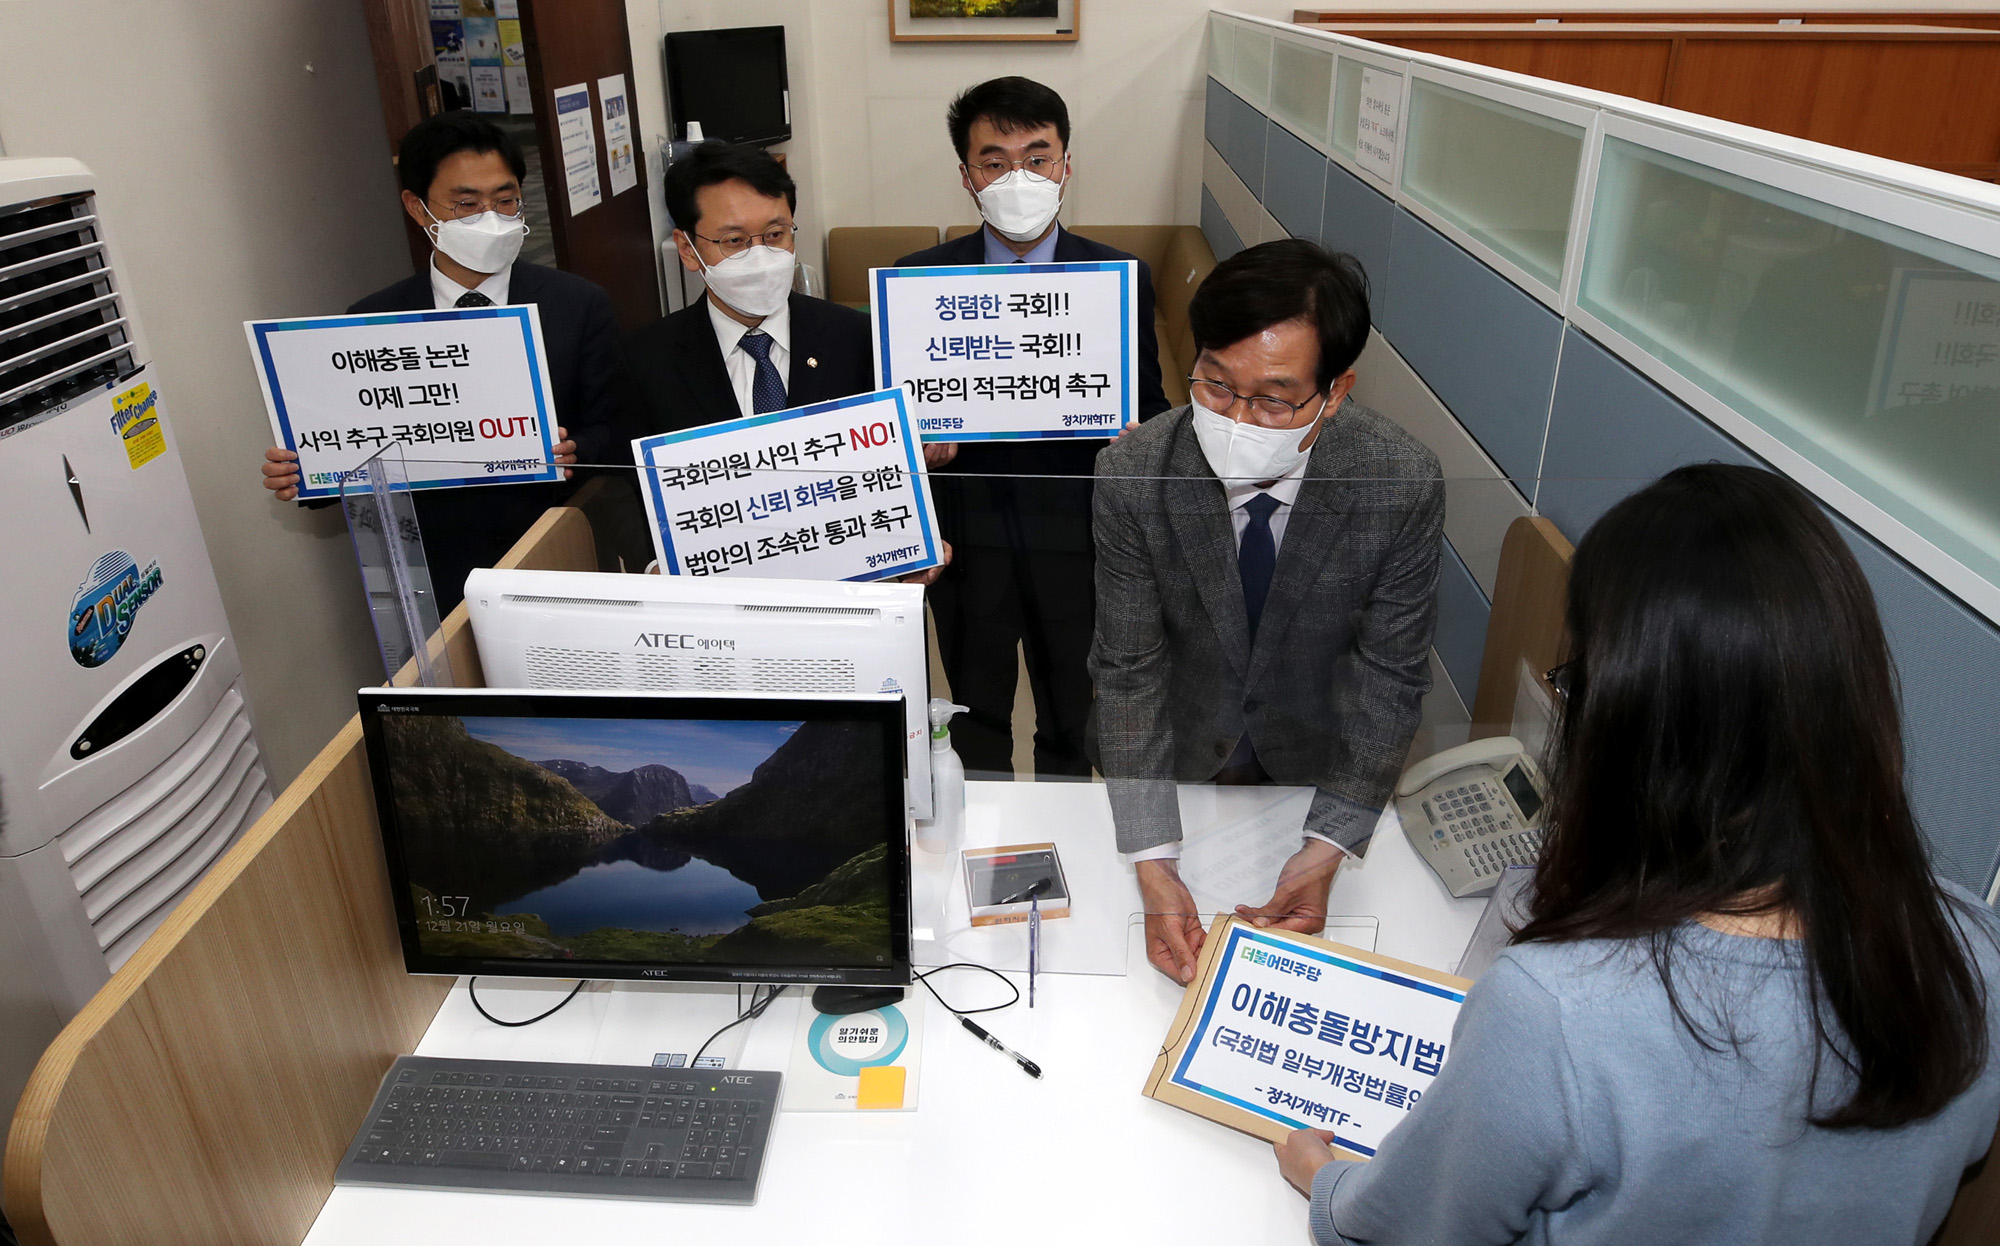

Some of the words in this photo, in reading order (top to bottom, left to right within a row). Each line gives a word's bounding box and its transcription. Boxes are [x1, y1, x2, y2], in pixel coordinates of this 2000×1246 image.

[935, 294, 1002, 321] 청렴한
[1007, 292, 1069, 318] 국회!!
[331, 347, 421, 373] 이해충돌
[425, 343, 469, 368] 논란
[925, 334, 1015, 362] 신뢰받는
[1019, 333, 1081, 358] 국회!!
[358, 386, 403, 410] 이제
[408, 383, 460, 406] 그만!
[903, 377, 967, 402] 야당의
[973, 374, 1060, 401] 적극참여
[1066, 373, 1111, 398] 촉구
[110, 404, 133, 435] Filter
[917, 418, 964, 430] 어민주당
[1062, 414, 1116, 427] 정치개혁TF
[299, 429, 340, 452] 사익
[346, 426, 388, 449] 추구
[391, 420, 475, 445] 국회의원
[479, 417, 537, 439] OUT!
[662, 452, 752, 491] 국회의원
[755, 441, 798, 471] 사익
[804, 432, 846, 461] 추구
[850, 422, 897, 451] NO!
[309, 469, 369, 484] 더불어민주
[675, 500, 743, 534] 국회의
[747, 489, 792, 521] 신뢰
[795, 475, 857, 508] 회복을
[862, 464, 903, 493] 위한
[685, 541, 753, 576] 법안의
[757, 526, 819, 559] 조속한
[824, 515, 867, 545] 통과
[870, 505, 912, 533] 촉구
[865, 544, 920, 568] 정치개혁TF
[634, 633, 695, 650] ATEC
[697, 638, 735, 650] 에이텍
[421, 895, 470, 917] 1:57
[425, 920, 451, 933] 12월
[455, 921, 480, 933] 21일
[486, 920, 525, 935] 월요일
[1240, 945, 1322, 983] 더불어민주당
[1212, 1025, 1280, 1064] (국회법
[1231, 983, 1445, 1077] 이해충돌방지법
[720, 1076, 753, 1085] ATEC
[1266, 1086, 1351, 1127] 정치개혁TF
